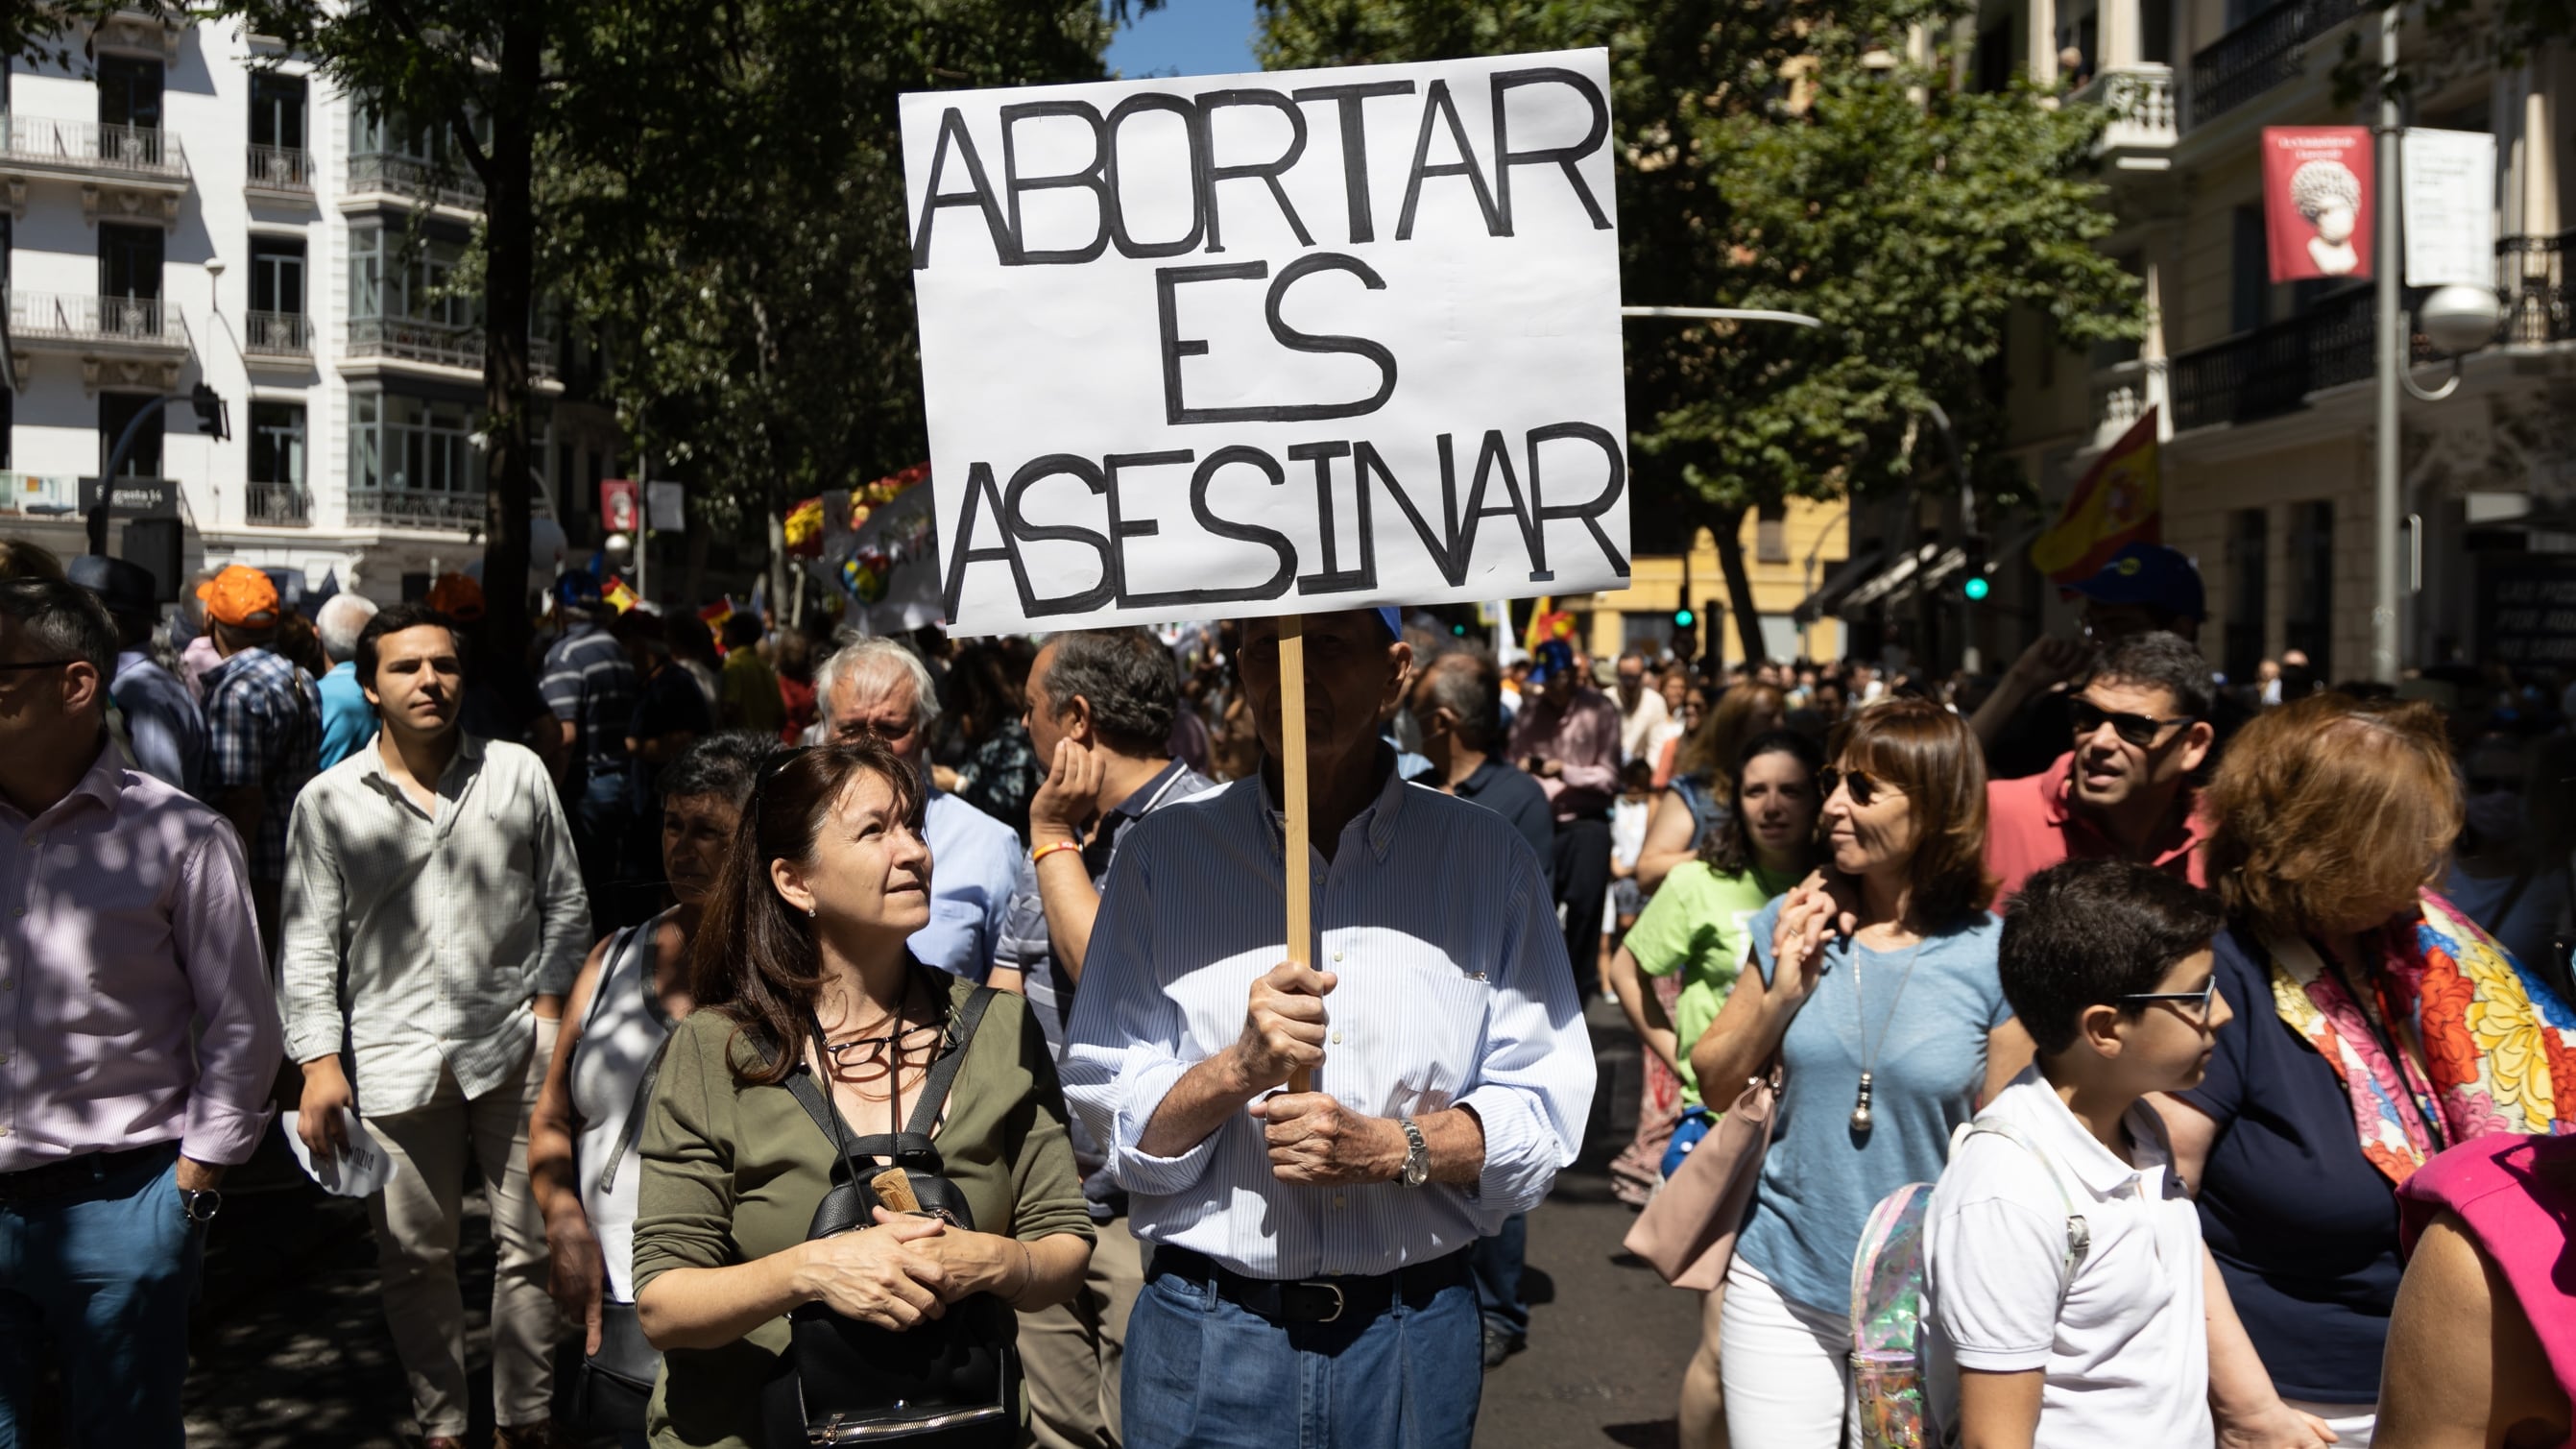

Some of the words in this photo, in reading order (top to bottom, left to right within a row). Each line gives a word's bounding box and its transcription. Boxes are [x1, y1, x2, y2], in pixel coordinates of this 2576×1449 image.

[913, 66, 1613, 270] ABORTAR
[1155, 252, 1398, 426] ES
[95, 484, 148, 505] Sgasta
[943, 421, 1631, 626] ASESINAR
